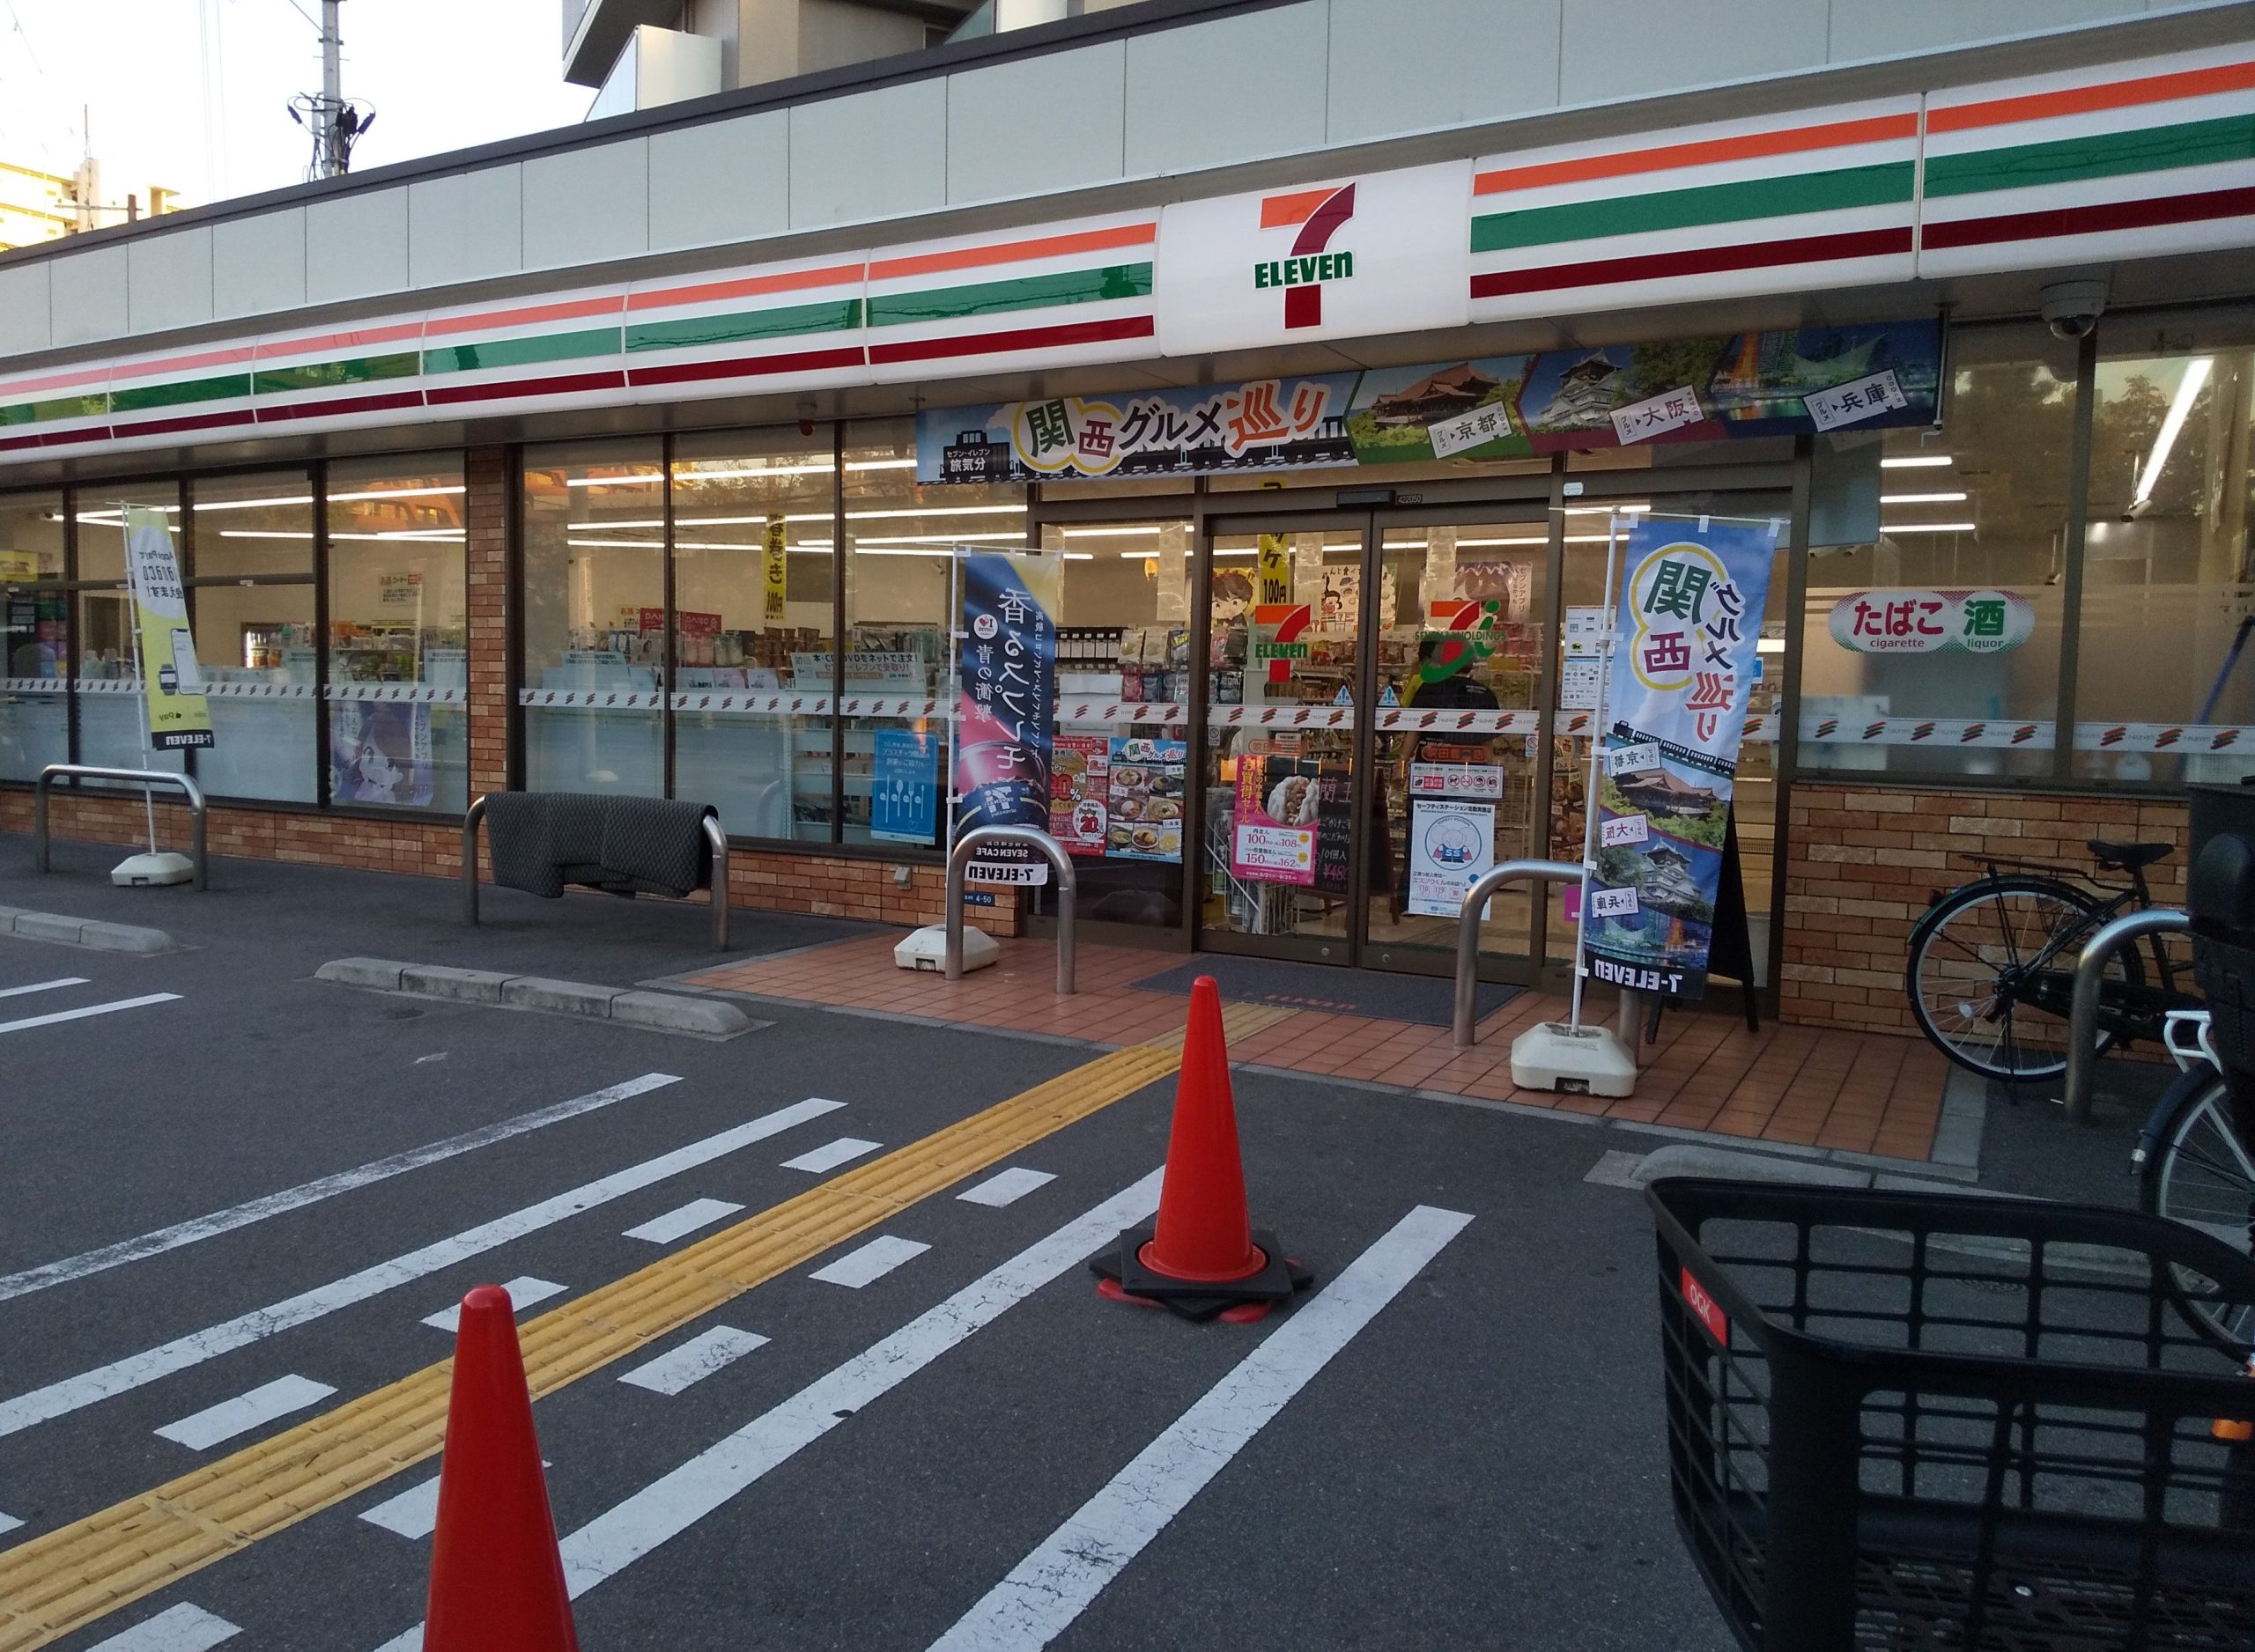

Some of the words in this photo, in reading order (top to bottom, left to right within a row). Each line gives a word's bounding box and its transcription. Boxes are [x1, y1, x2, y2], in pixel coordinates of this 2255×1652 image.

[1255, 251, 1353, 288] ELEVEn
[1841, 383, 1889, 413] 兵庫
[1025, 379, 1324, 460] 関西グルメ巡り
[1642, 398, 1689, 426] 大阪
[1815, 401, 1830, 421] グルメ
[1456, 413, 1497, 440] 京都
[1622, 416, 1632, 435] グルメ
[1437, 430, 1446, 449] グルメ
[950, 457, 986, 472] 旅気分
[1397, 494, 1422, 503] 422050
[1263, 579, 1286, 604] 100円
[1852, 599, 1944, 636] たばこ
[1963, 600, 2006, 636] 酒
[1255, 643, 1307, 658] ELEVEn
[1870, 638, 1925, 649] cigarette
[1967, 638, 2004, 649] liquor
[1281, 838, 1297, 848] 108
[1246, 853, 1265, 865] 150
[1280, 859, 1296, 867] 162
[976, 895, 992, 903] 4-50
[1690, 1284, 1710, 1324] OGK
